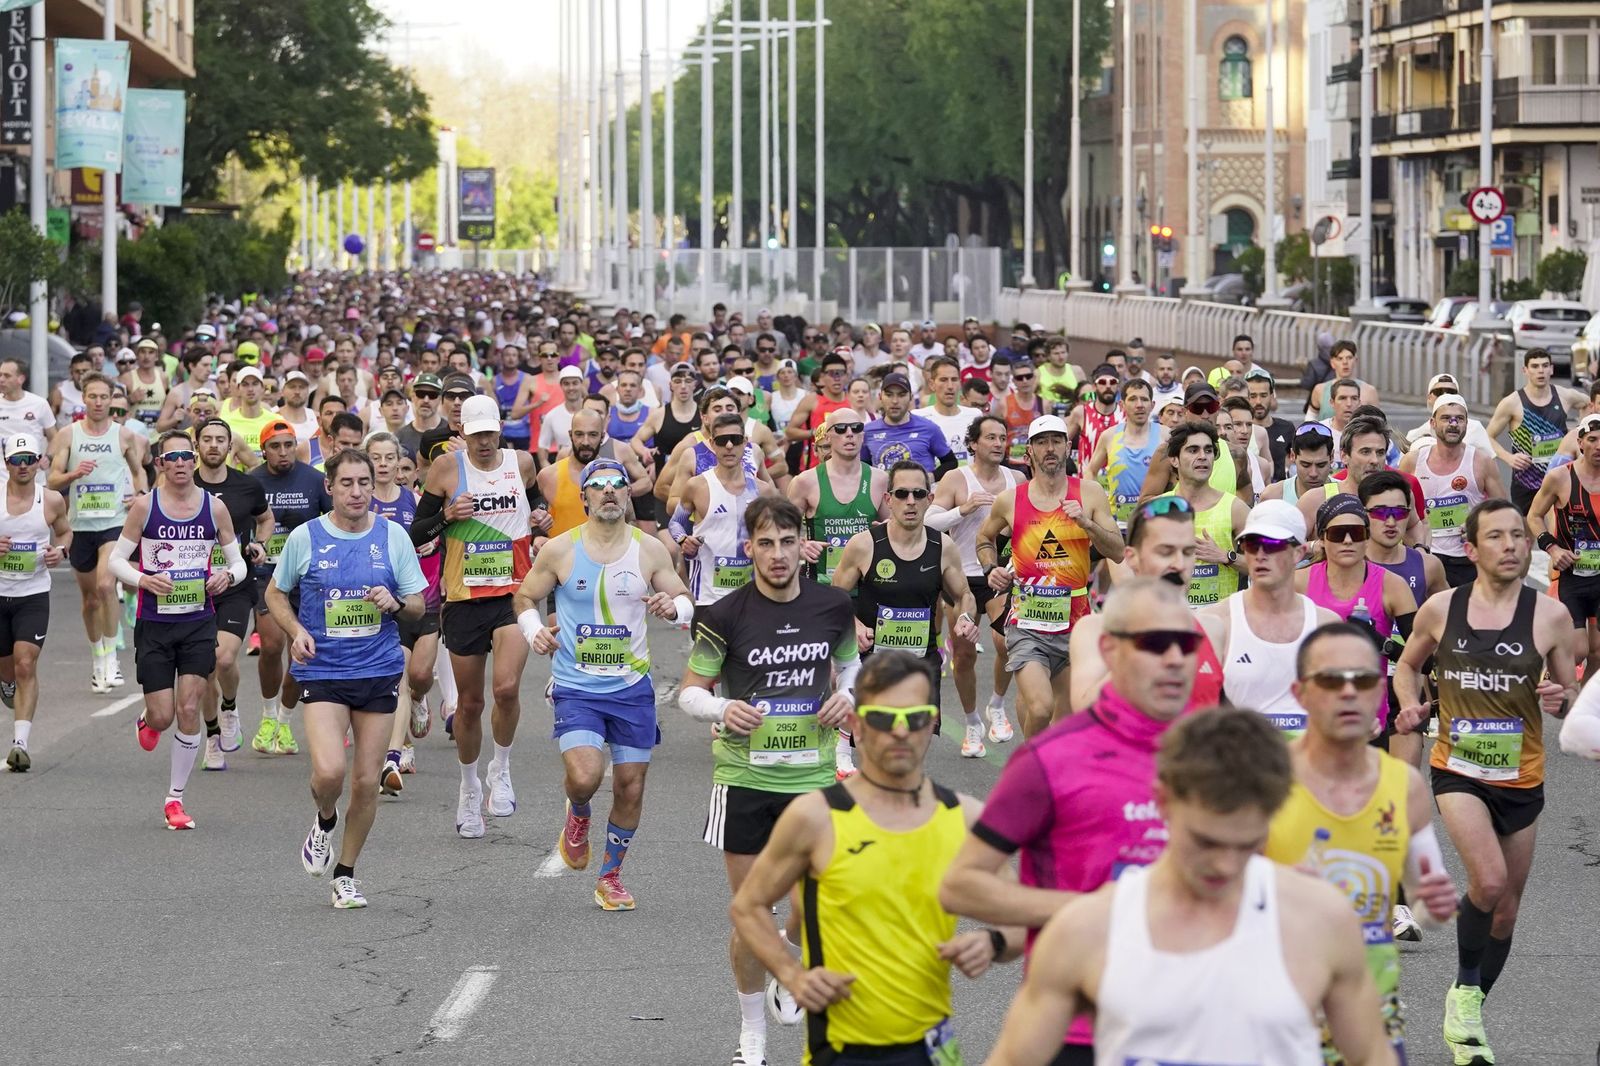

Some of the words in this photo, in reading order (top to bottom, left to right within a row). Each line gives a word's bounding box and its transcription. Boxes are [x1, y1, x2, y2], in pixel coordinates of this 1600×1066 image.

[1491, 220, 1507, 241] P
[78, 443, 112, 453] HOKA
[1438, 497, 1463, 506] ZURICH
[824, 518, 869, 526] PORTHCAWL
[1443, 518, 1454, 527] RA
[158, 525, 205, 539] GOWER
[825, 525, 869, 535] RUNNERS
[178, 544, 206, 552] CANCER
[480, 543, 507, 551] ZURICH
[3, 562, 24, 571] FRED
[174, 571, 200, 579] ZURICH
[464, 567, 513, 576] ALEMARJEN
[1192, 567, 1213, 576] RICH
[344, 589, 370, 597] ZURIC
[1036, 588, 1066, 596] ZURICH
[166, 593, 198, 604] GOWER
[1187, 593, 1219, 604] ORALES
[345, 604, 363, 612] 2432
[334, 613, 374, 626] JAVITIN
[896, 611, 925, 619] ZURICH
[1024, 609, 1064, 621] JUANMA
[594, 627, 626, 635] ZURICH
[881, 634, 923, 646] ARNAUD
[581, 652, 625, 664] ENRIQUE
[765, 667, 816, 688] TEAM
[775, 703, 813, 713] ZURICH
[1270, 717, 1302, 727] URICH
[1476, 722, 1515, 731] ZURICH
[776, 723, 798, 732] 2952
[763, 735, 807, 749] JAVIER
[1476, 740, 1497, 750] 2194
[1463, 750, 1510, 766] NICOCK
